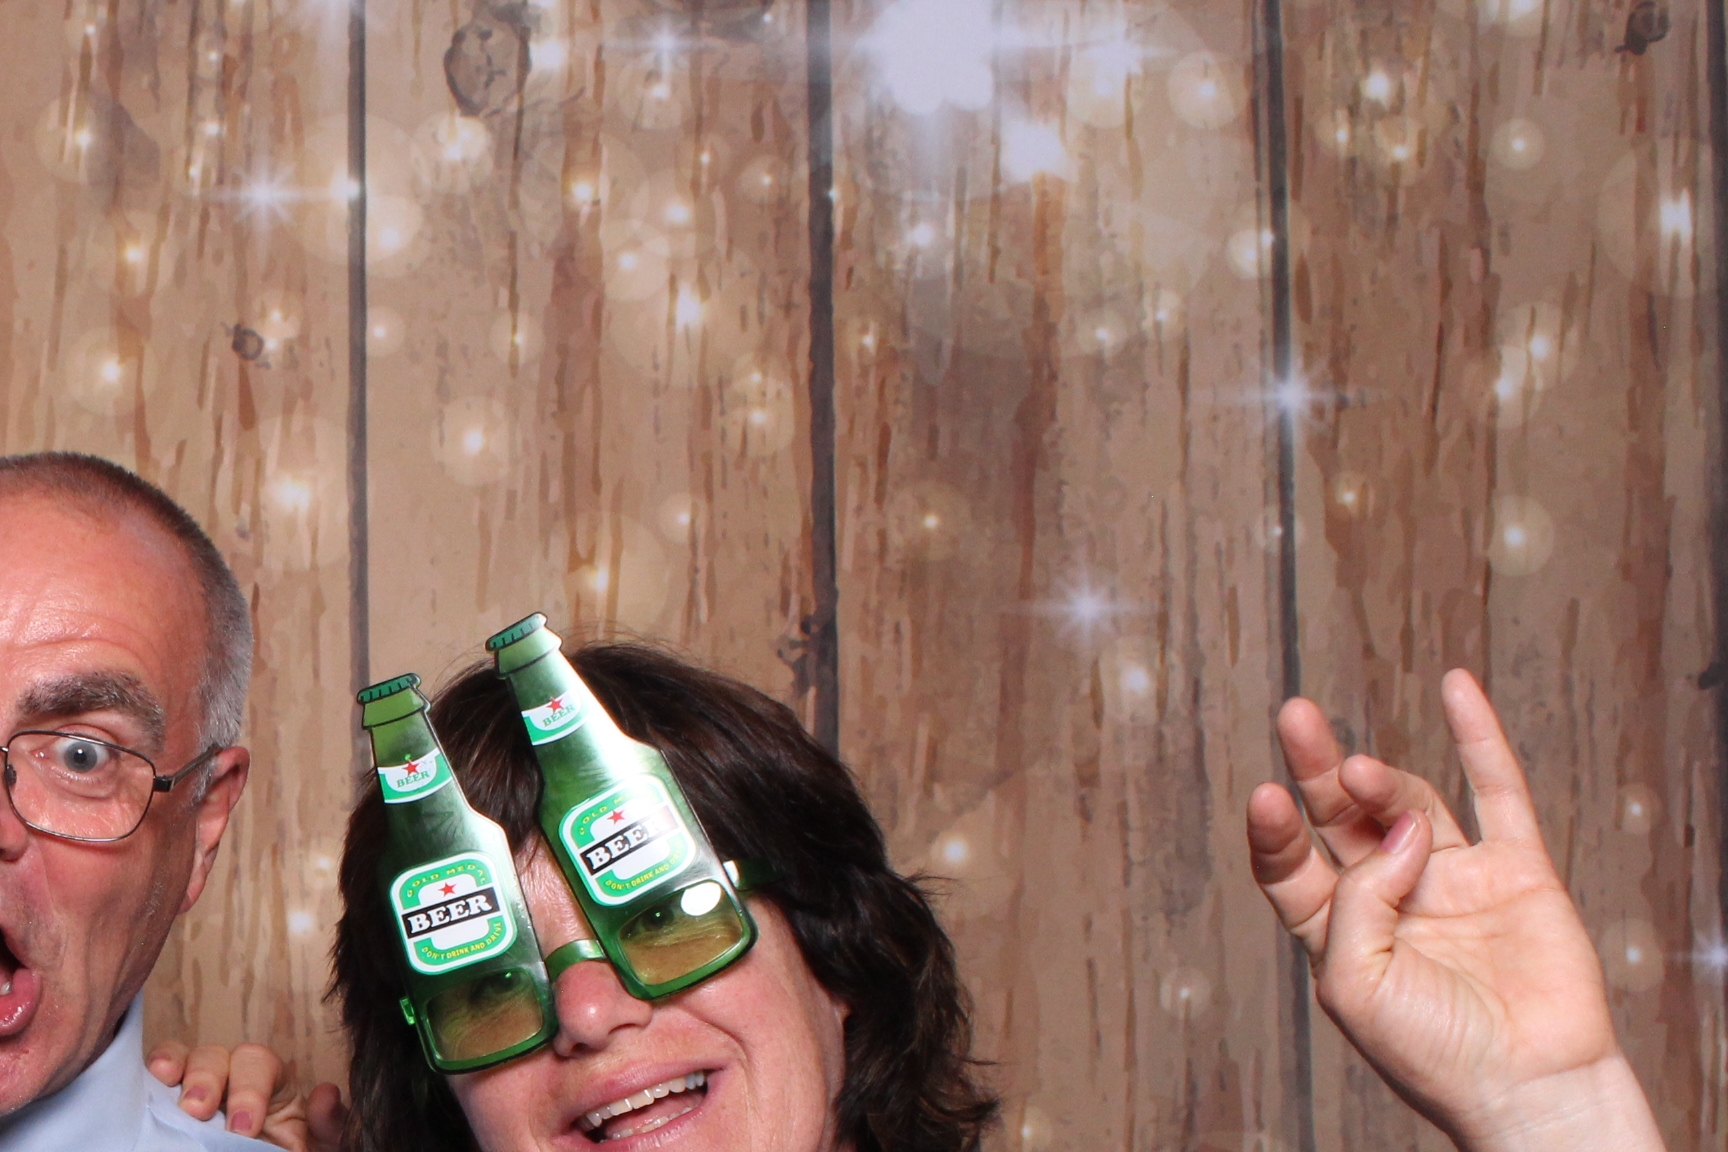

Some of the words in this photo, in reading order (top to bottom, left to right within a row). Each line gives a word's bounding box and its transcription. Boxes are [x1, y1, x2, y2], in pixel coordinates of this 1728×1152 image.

[542, 704, 575, 727] BEER
[396, 770, 430, 788] BEER
[585, 815, 668, 870] BEER
[407, 873, 440, 898] GOLD
[446, 864, 486, 884] MEDAL
[631, 872, 654, 887] DRINK
[654, 864, 670, 877] AND
[407, 895, 492, 934] BEER
[446, 947, 470, 959] DRINK
[470, 941, 486, 952] AND
[486, 921, 502, 945] DRIVE
